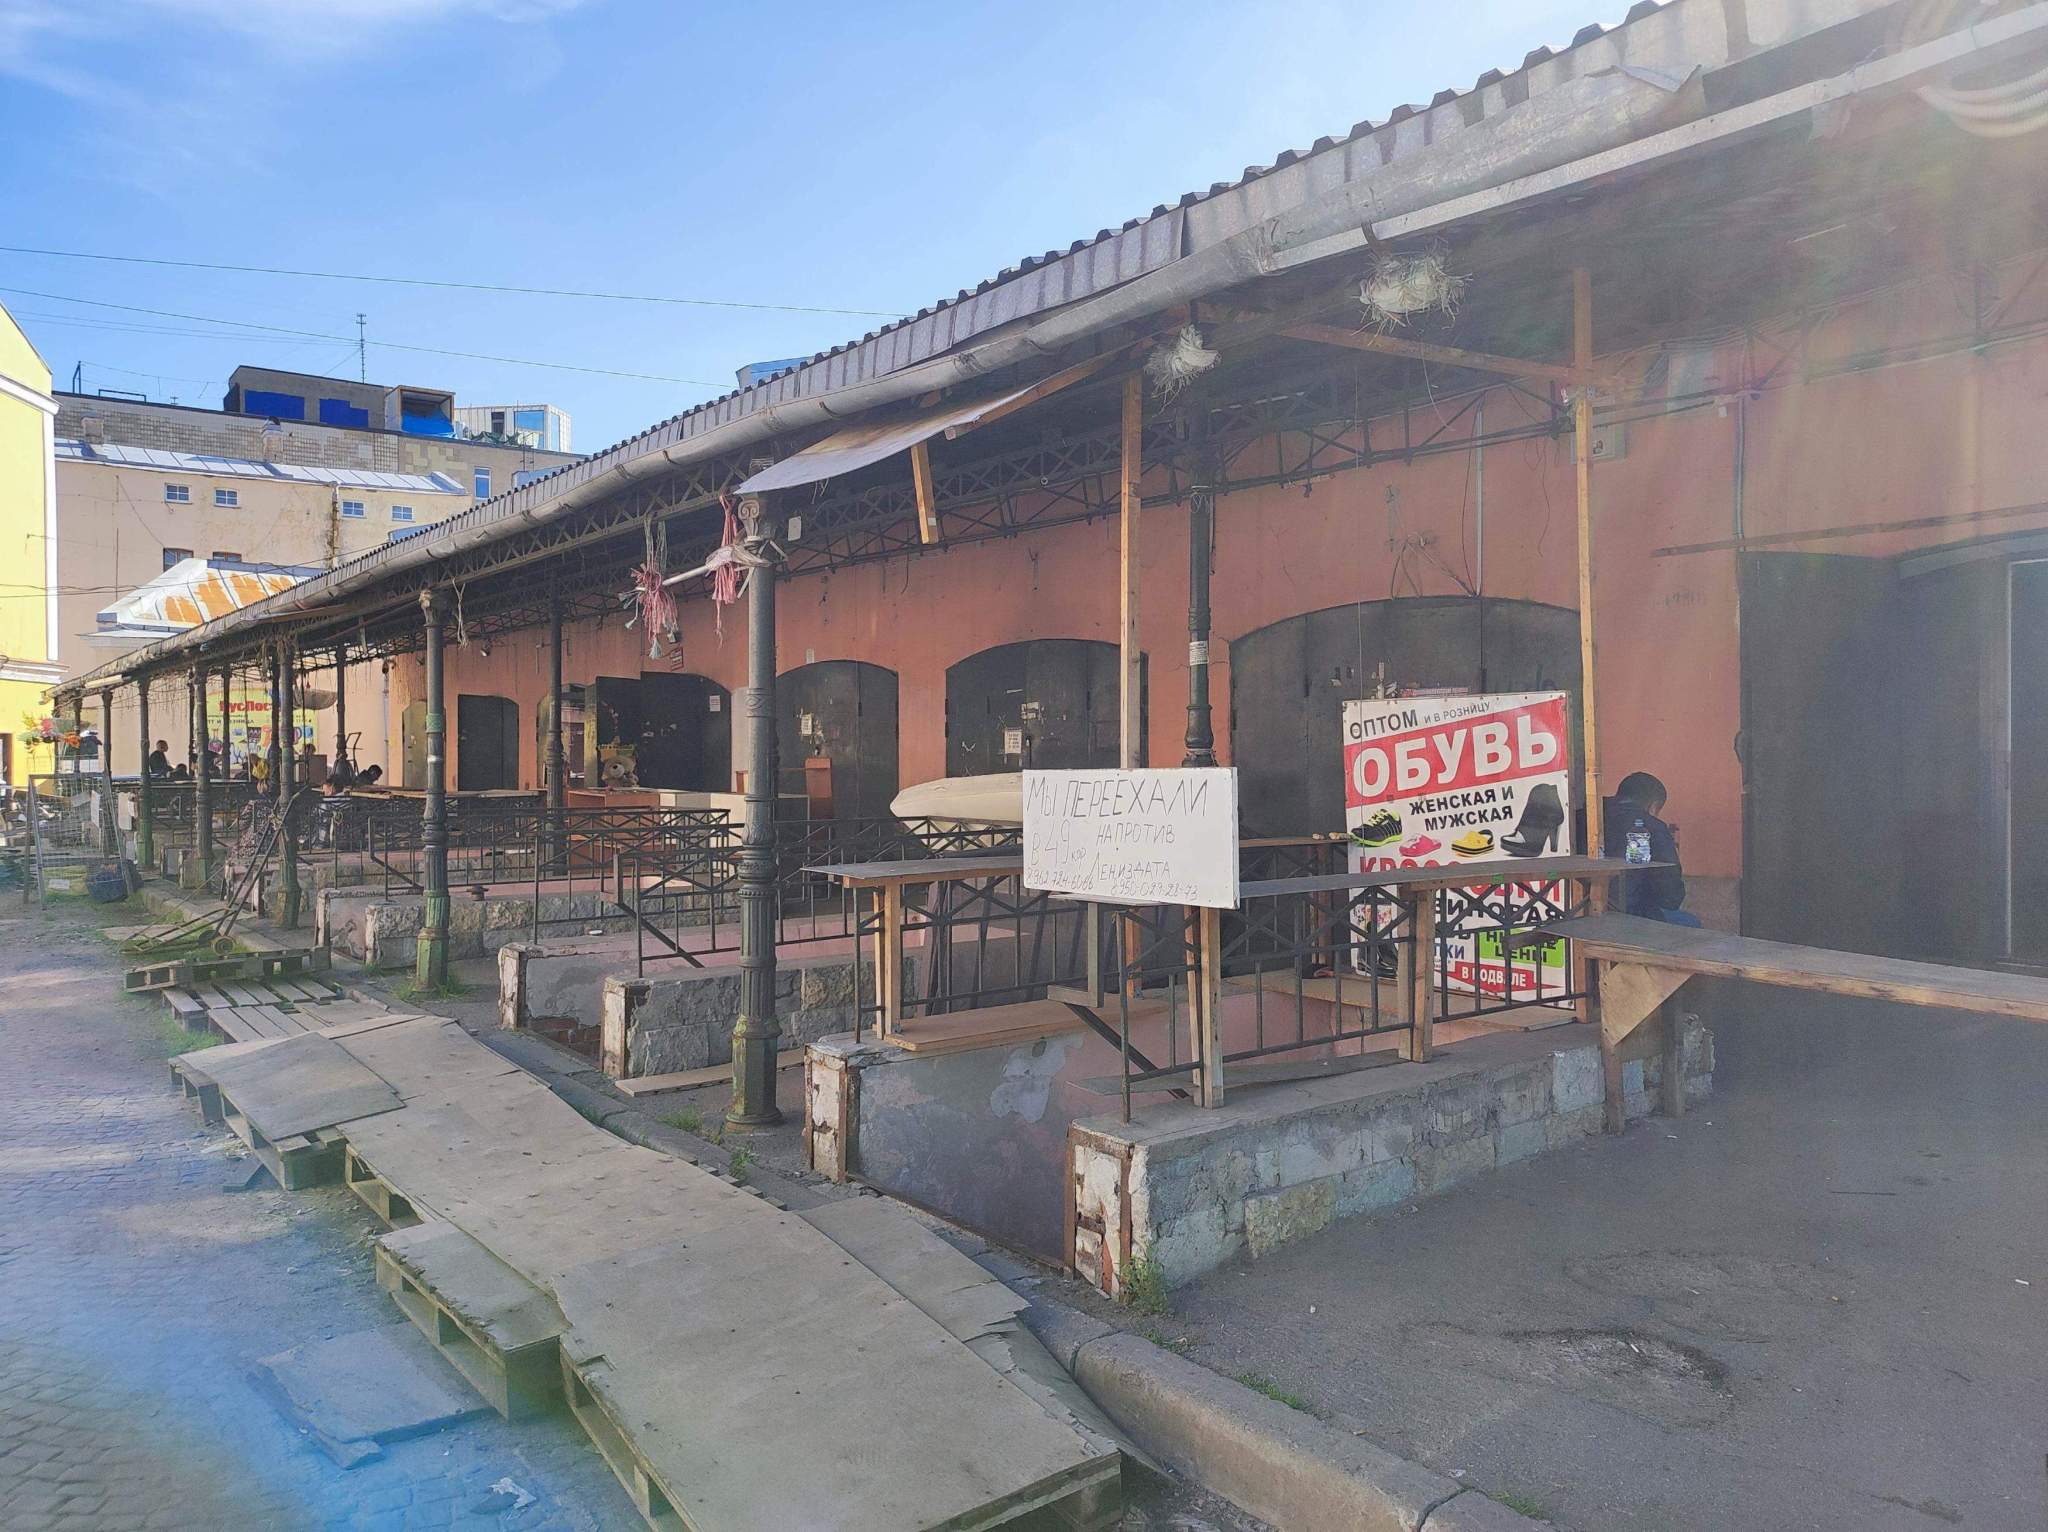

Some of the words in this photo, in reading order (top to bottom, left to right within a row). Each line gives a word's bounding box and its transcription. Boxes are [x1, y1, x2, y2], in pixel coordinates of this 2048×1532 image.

[1350, 709, 1418, 740] ОПТОМ
[1424, 715, 1431, 724] И
[1434, 713, 1441, 722] В
[1443, 701, 1490, 719] РОЗНИЦУ
[1353, 714, 1557, 797] ОБУВЬ
[1063, 778, 1208, 817] ПЕРЕЕХАЛИ
[1409, 788, 1495, 815] ЖЕНСКАЯ
[1502, 785, 1514, 800] И
[1424, 805, 1513, 831] МУЖСКАЯ
[1096, 823, 1175, 845] НАПРОТИВ
[1462, 966, 1469, 979] В
[1472, 968, 1526, 986] ОДВЛЕ
